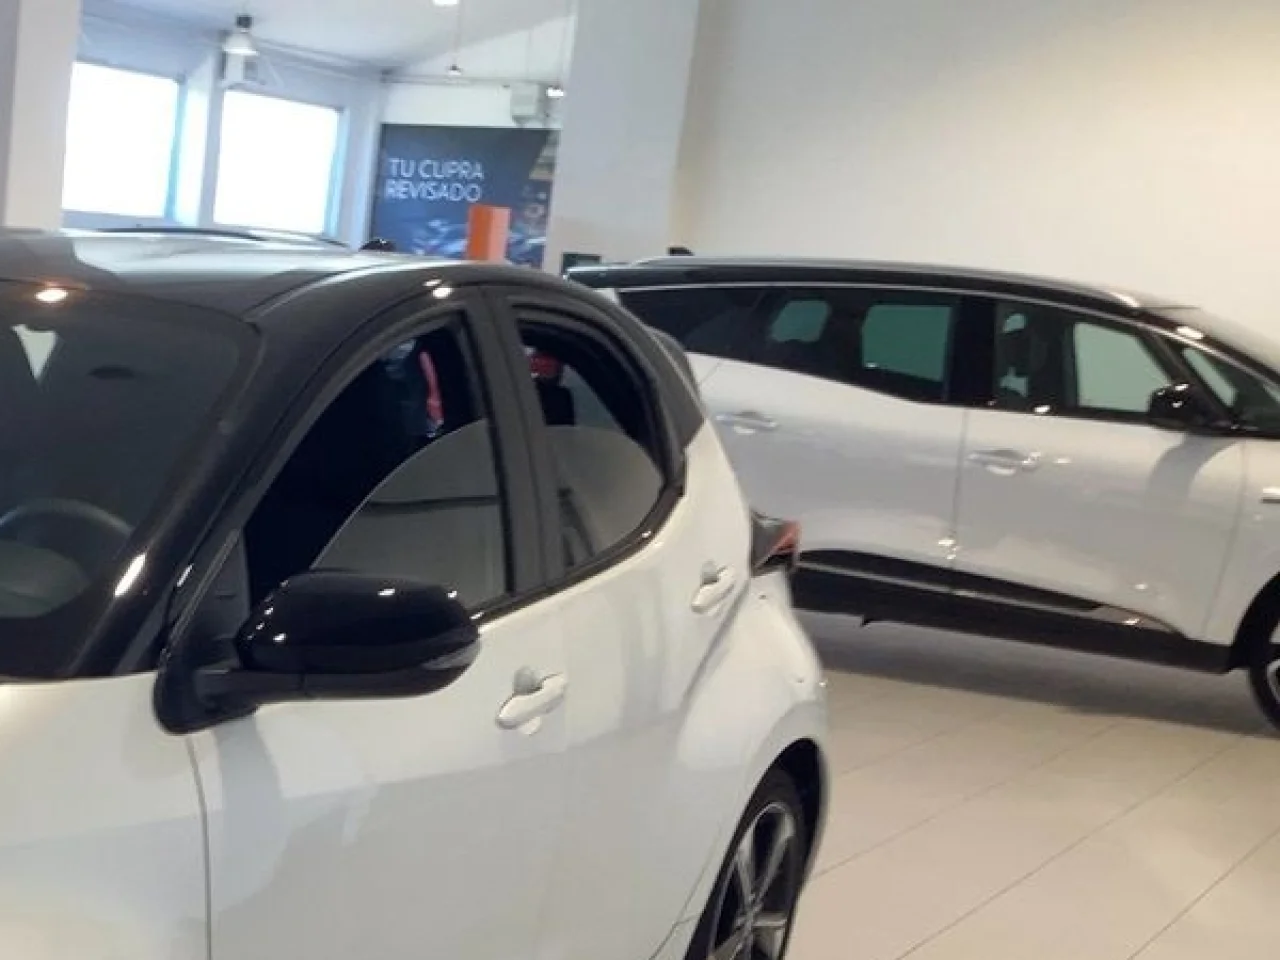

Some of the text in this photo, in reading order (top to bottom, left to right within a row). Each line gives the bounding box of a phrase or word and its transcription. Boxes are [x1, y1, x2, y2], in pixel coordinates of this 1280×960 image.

[388, 157, 484, 179] TU CUPRA
[385, 179, 482, 202] REVISADO
